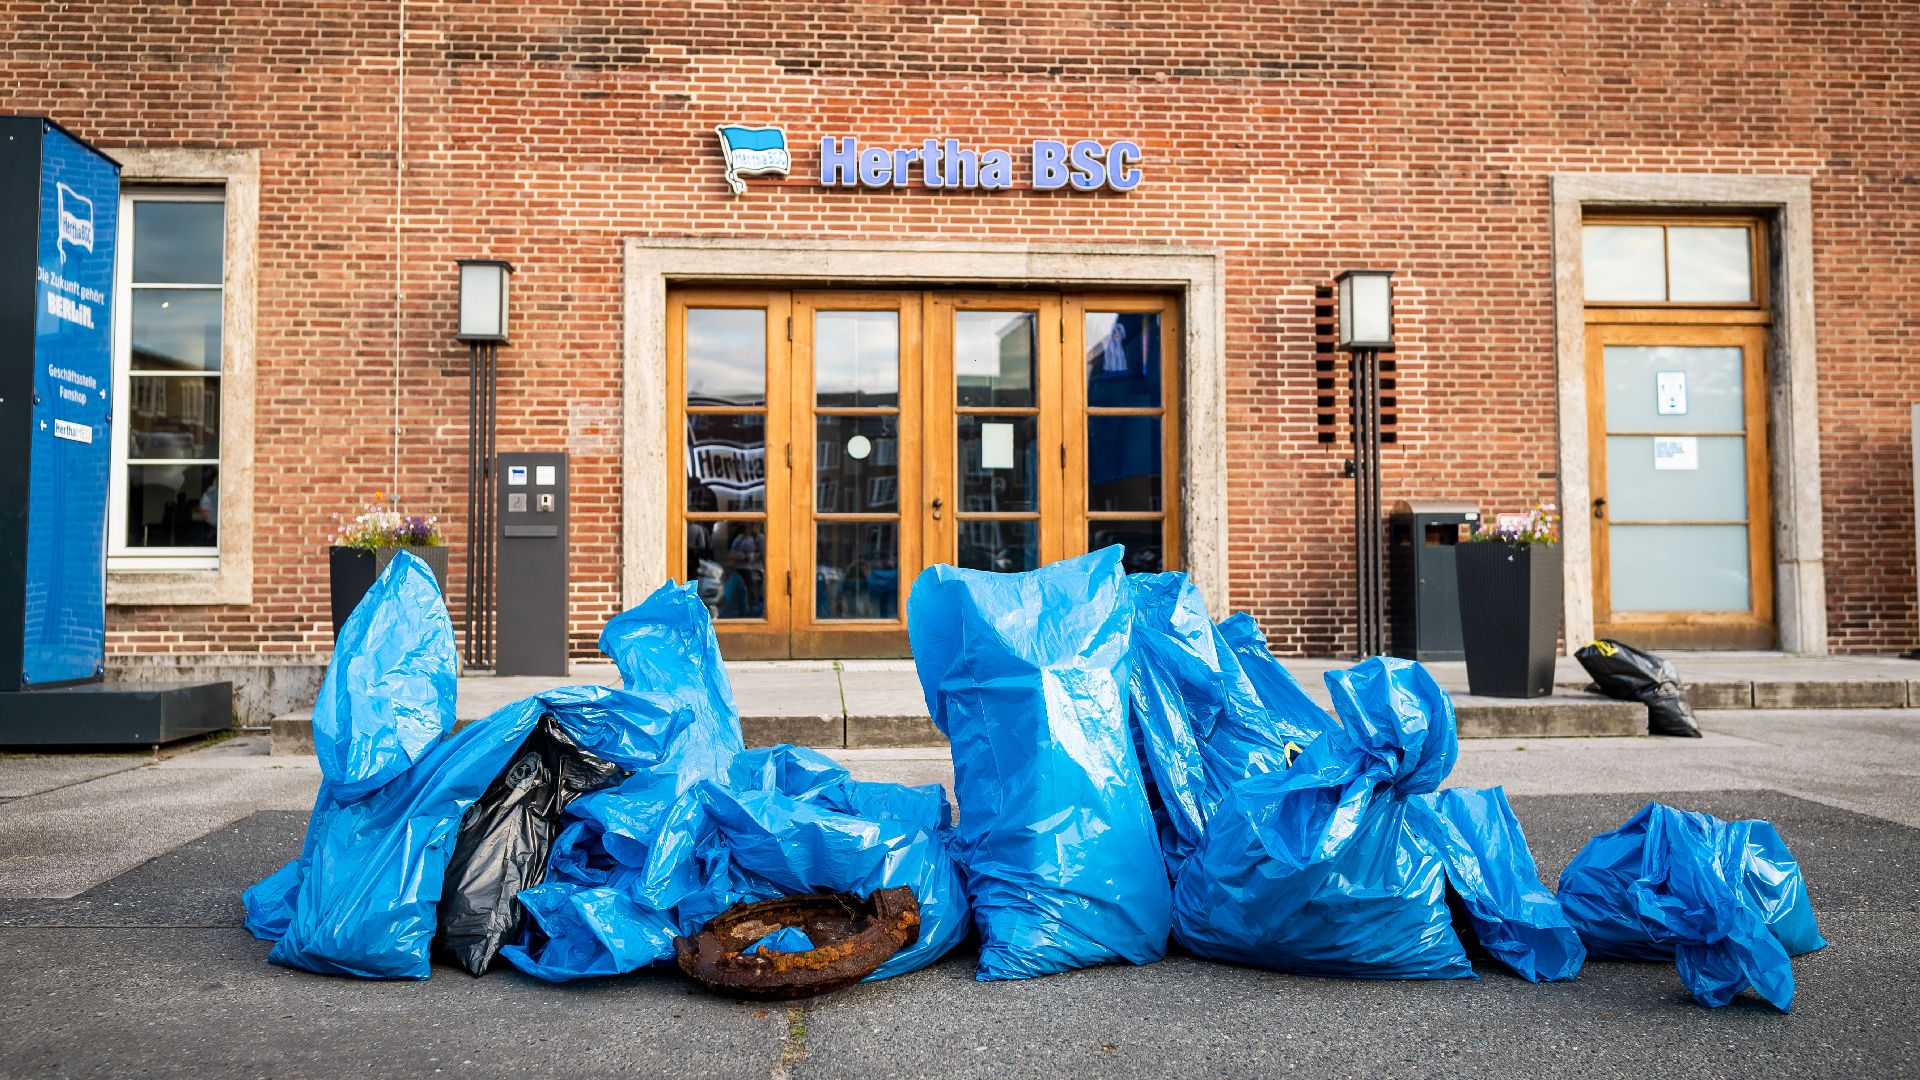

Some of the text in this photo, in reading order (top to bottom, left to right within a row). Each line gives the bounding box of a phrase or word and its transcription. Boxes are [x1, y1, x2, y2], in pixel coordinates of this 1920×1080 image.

[820, 136, 1143, 192] Hertha BSC
[38, 266, 104, 306] Die Zukunft gehört
[48, 363, 97, 390] Geschäftsstelle
[60, 385, 87, 406] Fanshop
[697, 449, 765, 483] Hertha
